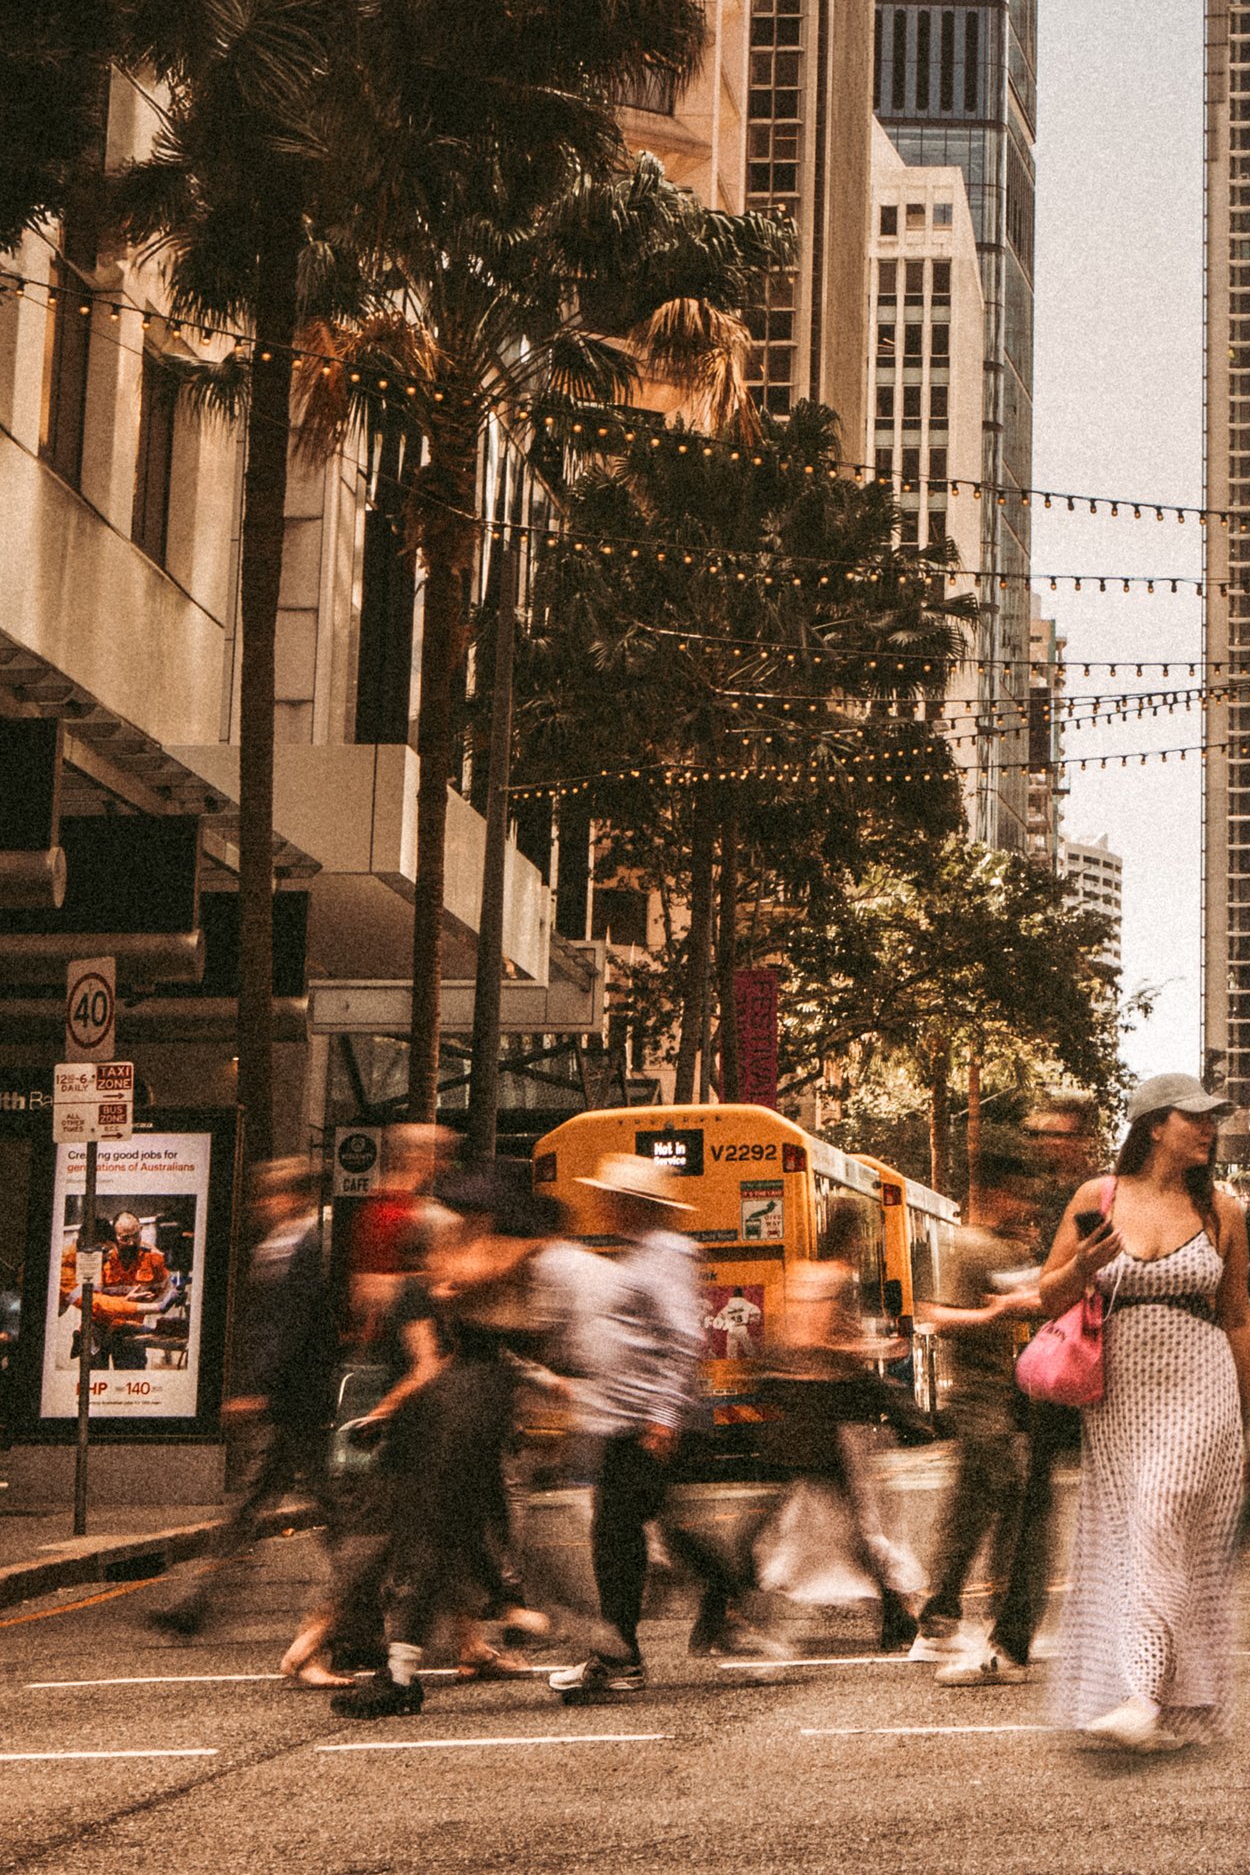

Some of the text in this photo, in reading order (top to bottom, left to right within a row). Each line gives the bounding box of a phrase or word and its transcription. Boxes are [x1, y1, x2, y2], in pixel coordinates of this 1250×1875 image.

[74, 990, 107, 1028] 40
[750, 980, 773, 1102] FESTIVAL
[100, 1066, 130, 1077] TAXI
[61, 1084, 88, 1092] DAILY
[98, 1078, 131, 1090] ZONE
[103, 1105, 123, 1114] BUS
[100, 1114, 125, 1123] ZONE
[653, 1141, 686, 1156] Not in
[710, 1144, 777, 1162] V2292
[68, 1150, 178, 1161] Creng good jobs for
[653, 1155, 687, 1166] Service
[67, 1162, 195, 1173] genations of Australians
[126, 1381, 151, 1396] 140
